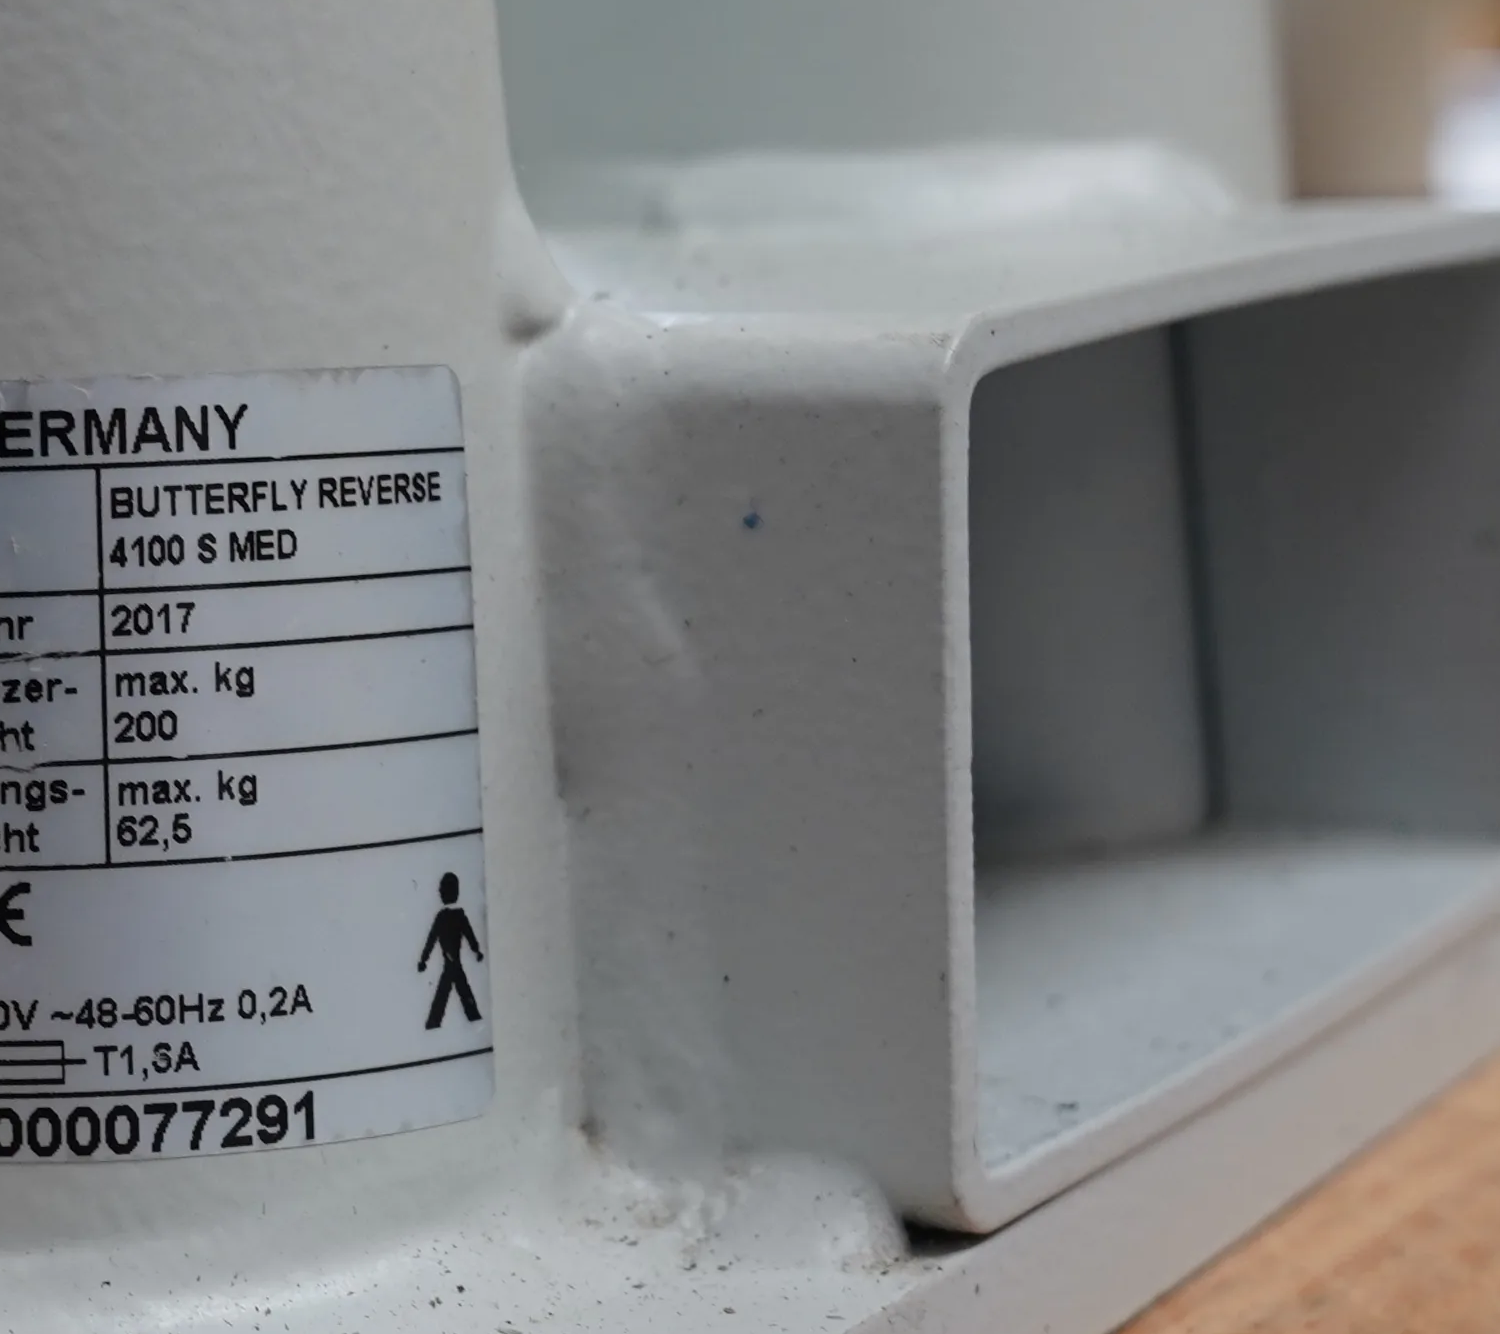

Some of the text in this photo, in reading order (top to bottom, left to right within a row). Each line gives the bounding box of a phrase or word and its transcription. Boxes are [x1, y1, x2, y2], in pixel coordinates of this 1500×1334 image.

[110, 471, 441, 519] BUTTERFLY REVERSE
[109, 529, 297, 567] 4100 S MED
[111, 603, 195, 637] 2017
[115, 662, 254, 697] max. kg
[114, 710, 177, 743] 200
[118, 770, 257, 806] max. kg
[117, 814, 192, 852] 62,5
[238, 984, 313, 1025] 0,2A
